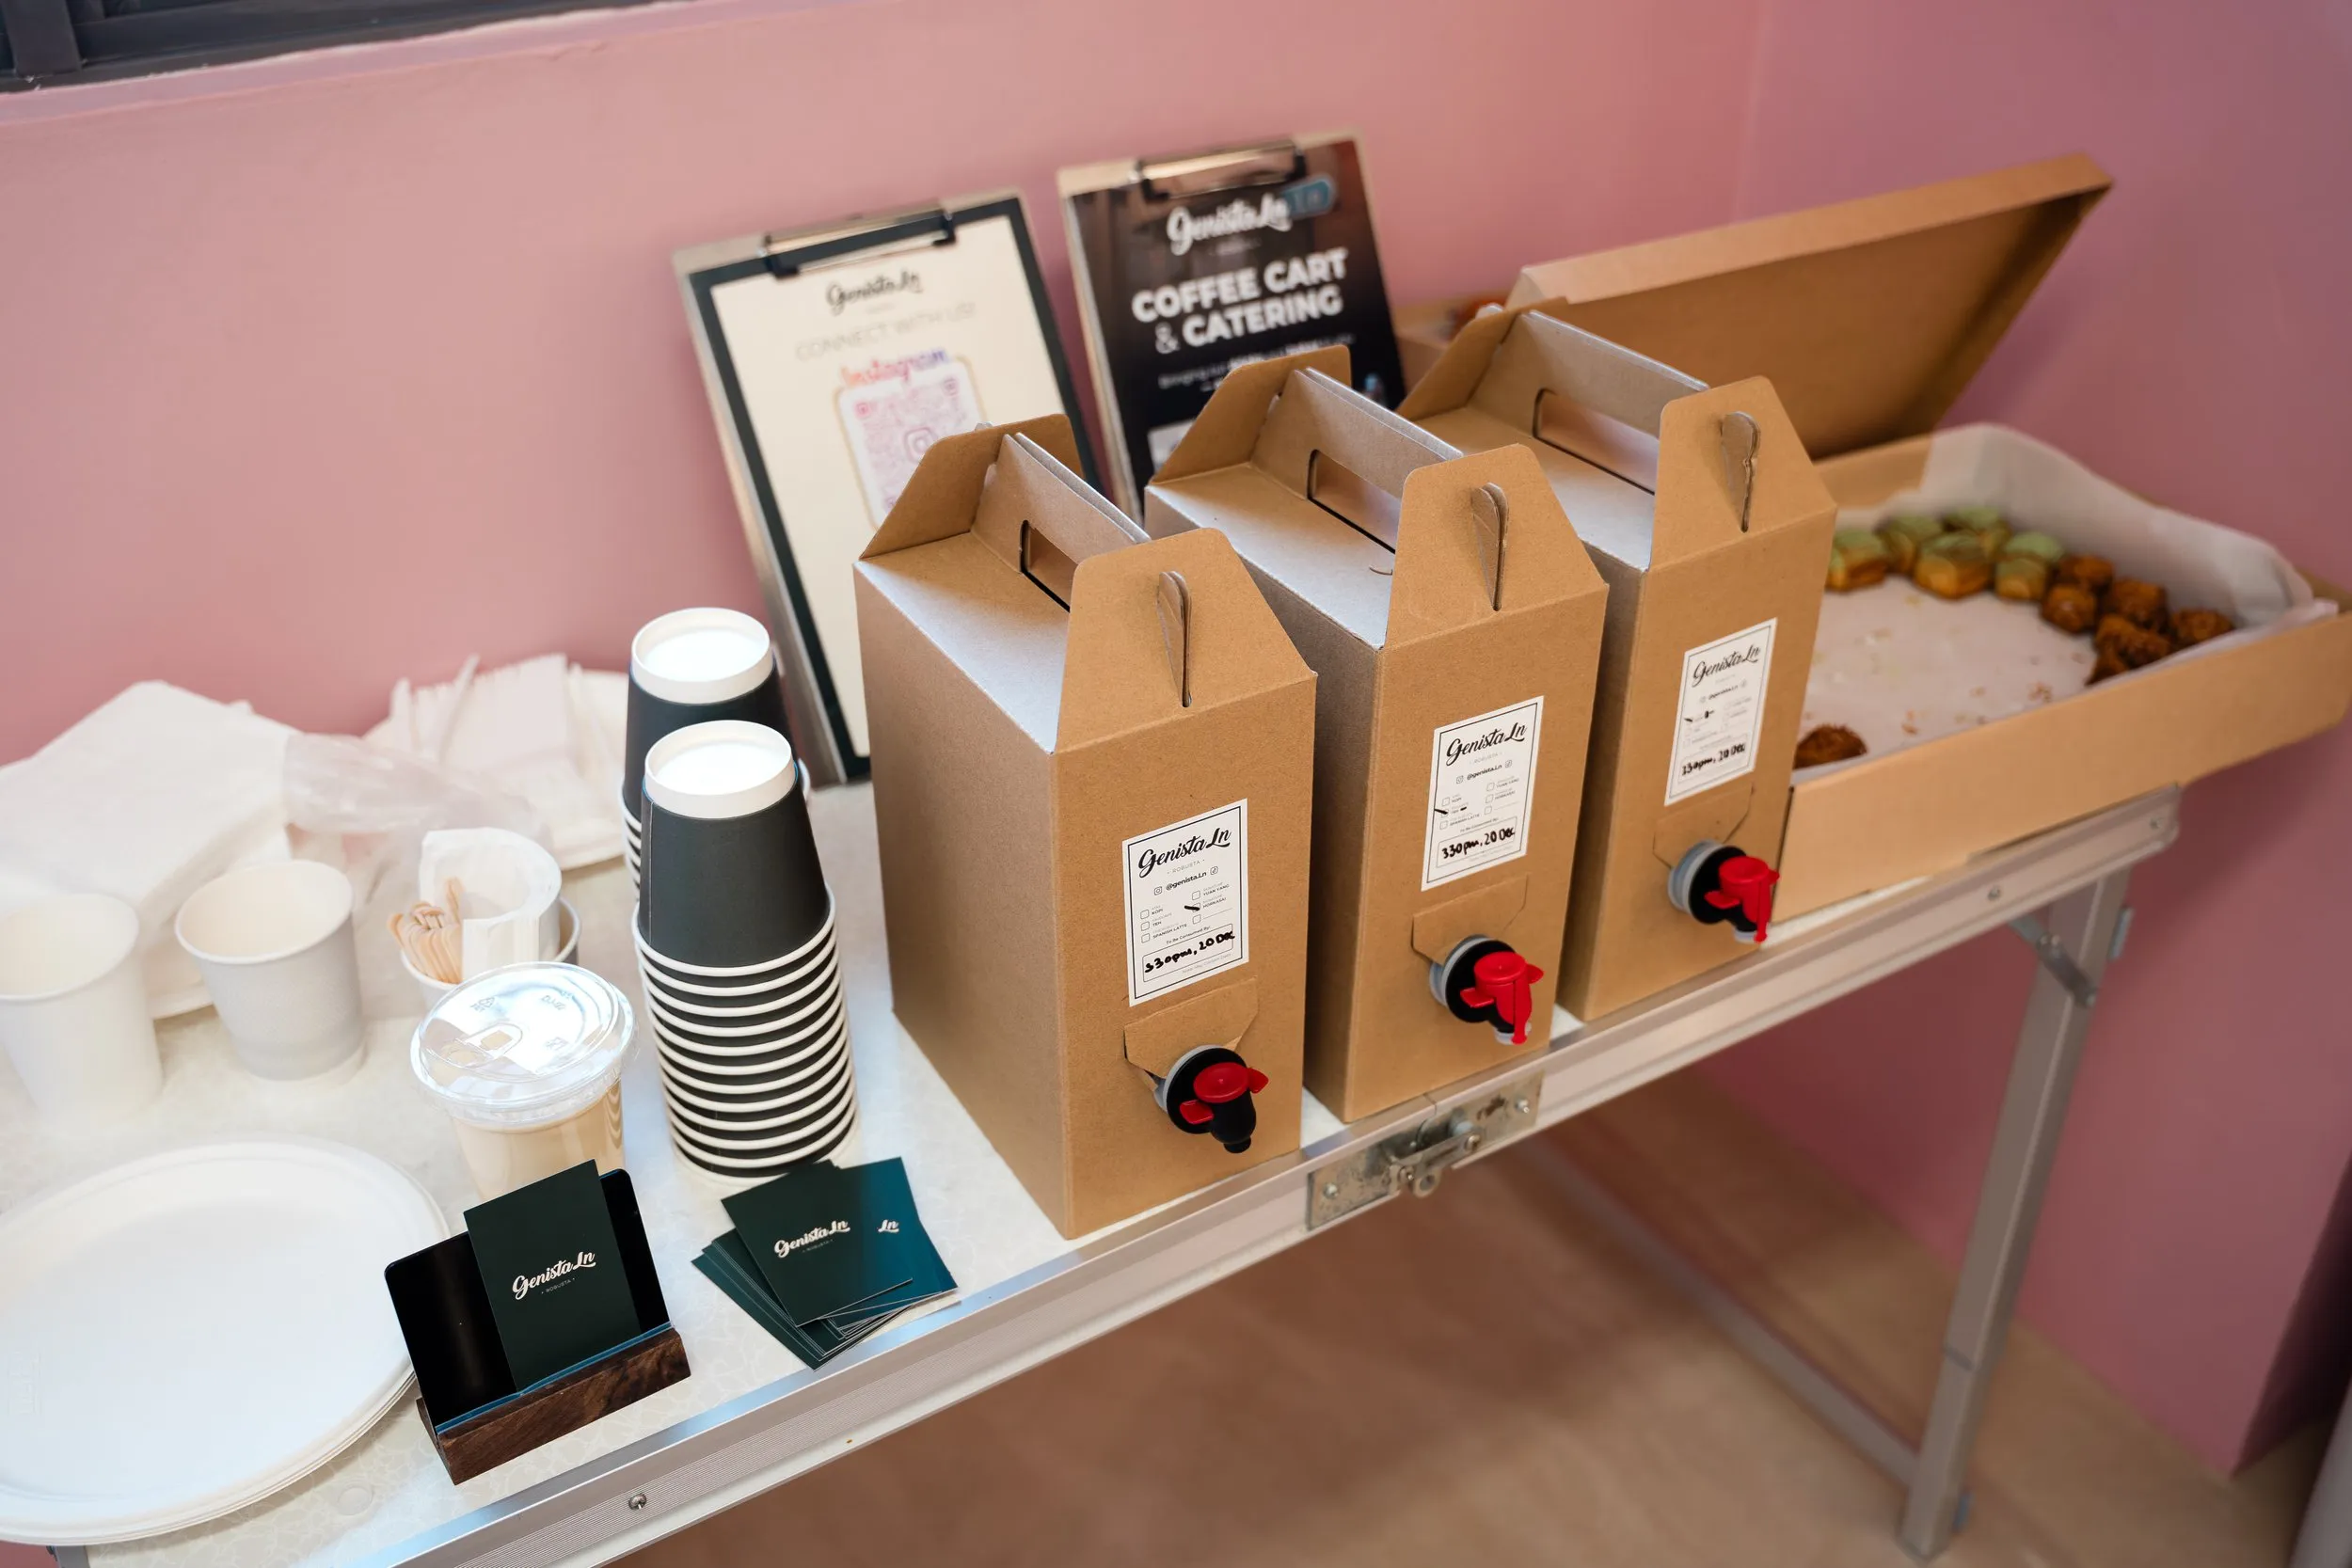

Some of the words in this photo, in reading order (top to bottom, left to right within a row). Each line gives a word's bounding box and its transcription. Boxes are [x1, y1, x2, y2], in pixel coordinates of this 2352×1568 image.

[1131, 266, 1262, 323] COFFEE
[1263, 246, 1348, 293] CART
[1154, 322, 1180, 355] &
[1182, 285, 1344, 348] CATERING
[796, 323, 887, 361] CONNECT
[1446, 729, 1505, 766] Genista
[1484, 831, 1497, 845] 20
[1138, 835, 1206, 878] Genista
[1172, 860, 1200, 873] ROBUSTA
[1166, 872, 1207, 890] @genista.Ln
[1203, 888, 1217, 896] YUAN
[1152, 928, 1172, 939] SPANISH
[1173, 922, 1187, 931] LATTE
[1199, 938, 1214, 950] 20
[878, 1219, 899, 1233] Ln
[774, 1227, 829, 1258] Genista
[512, 1259, 573, 1300] Genista
[546, 1279, 571, 1293] ROBUSTA
